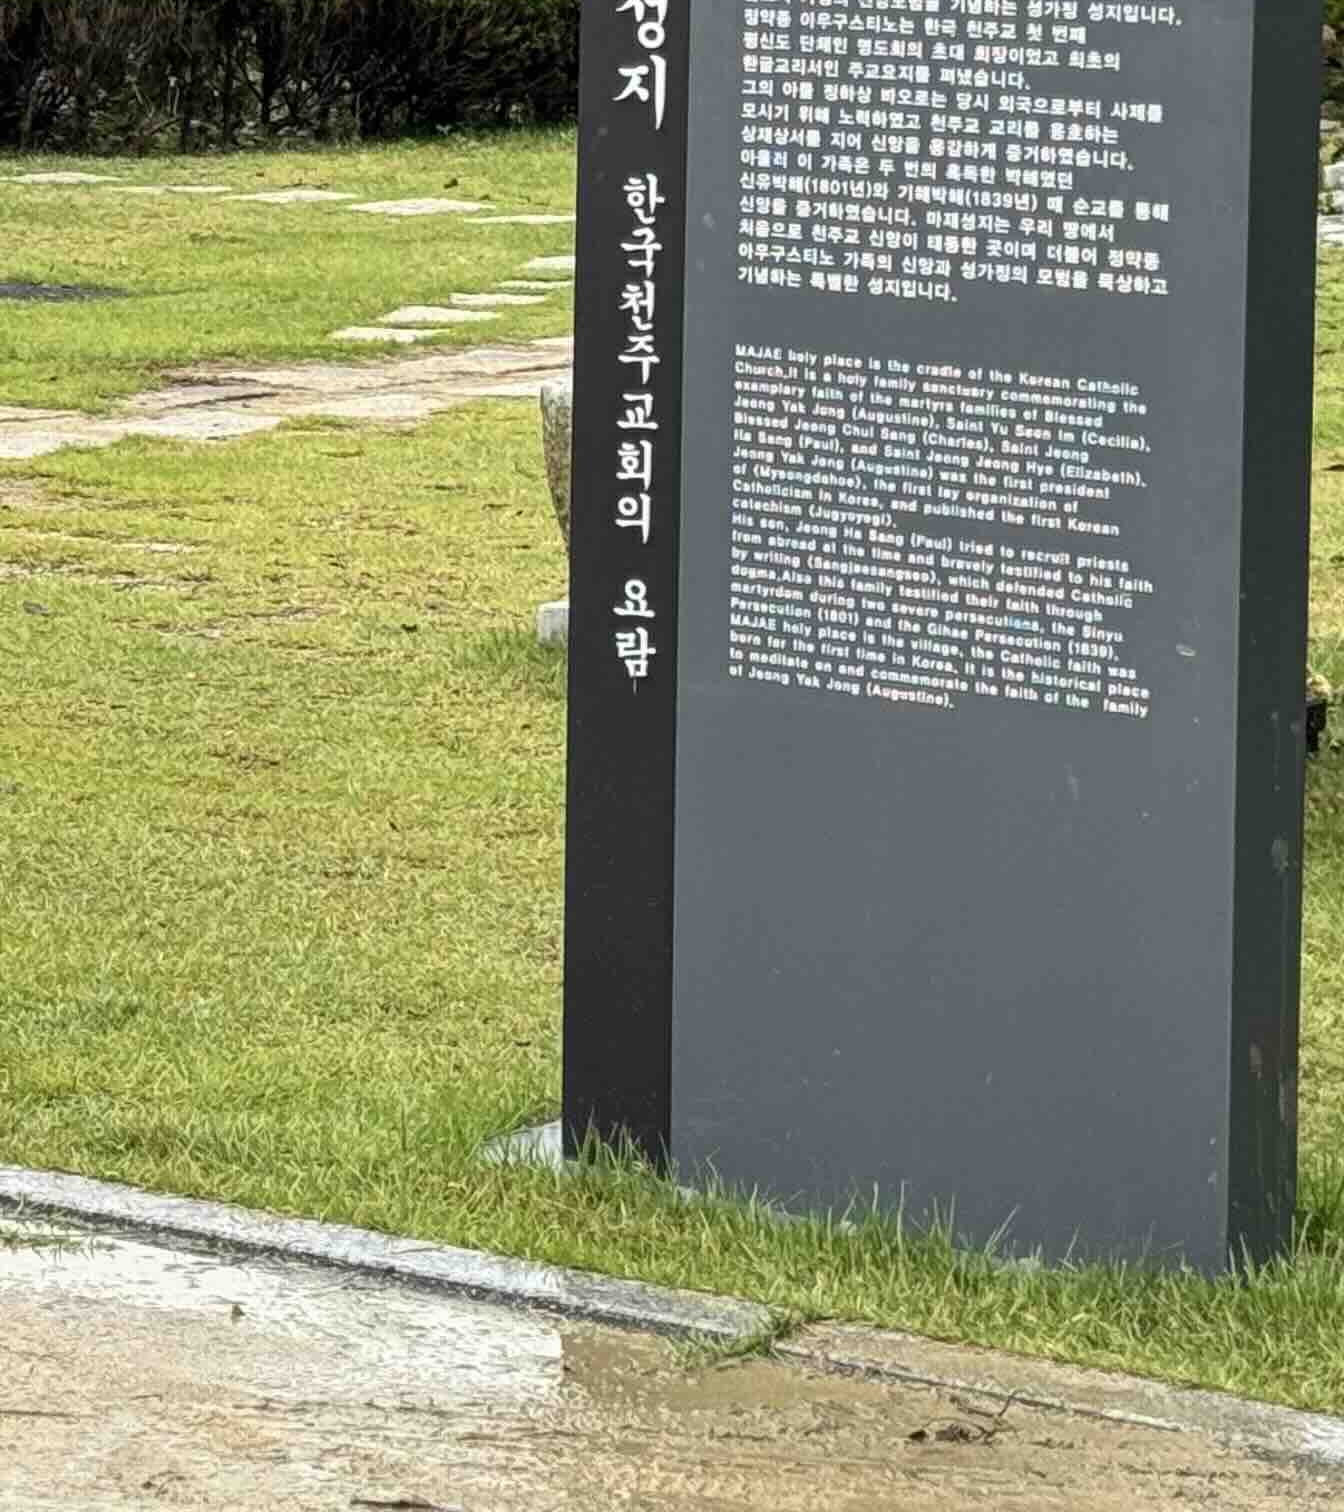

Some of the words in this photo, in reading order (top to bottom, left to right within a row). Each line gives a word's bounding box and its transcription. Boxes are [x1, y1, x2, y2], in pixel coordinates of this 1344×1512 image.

[743, 7, 791, 28] 정약종
[924, 16, 956, 37] 한국
[966, 19, 1016, 39] 천주교
[1025, 22, 1042, 41] 첫
[1026, 0, 1077, 19] 성가정
[1087, 1, 1181, 25] 성지입니다.
[742, 31, 790, 50] 평신도
[799, 34, 847, 54] 단체인
[856, 38, 922, 59] 명도회의
[930, 41, 964, 61] 초대
[973, 44, 1059, 65] 회장이었고
[1068, 49, 1120, 71] 최초의
[742, 53, 838, 77] 한글교리서인
[847, 61, 930, 83] 주교요지를
[740, 102, 789, 121] 모시기
[798, 105, 830, 124] 위해
[837, 108, 921, 129] 노력하였고
[930, 113, 980, 133] 천주교
[988, 119, 1039, 139] 교리를
[741, 79, 773, 96] 그의
[781, 81, 813, 99] 아들
[823, 83, 872, 104] 정하상
[955, 91, 989, 111] 당시
[997, 95, 1101, 119] 외국으로부터
[1110, 101, 1162, 123] 사제를
[740, 124, 820, 147] 상재상서를
[830, 130, 861, 150] 지어
[871, 133, 920, 154] 신앙을
[1005, 143, 1133, 170] 증거하였습니다.
[797, 152, 812, 170] 이
[821, 154, 870, 174] 가족은
[878, 158, 895, 176] 두
[903, 159, 936, 180] 번의
[739, 194, 787, 215] 신앙을
[795, 199, 916, 226] 증거하였습니다.
[925, 210, 1010, 233] 마재성지는
[1018, 217, 1052, 237] 우리
[1072, 197, 1124, 218] 순교를
[738, 218, 802, 239] 처음으로
[811, 223, 860, 244] 천주교
[868, 229, 918, 250] 신앙이
[926, 234, 977, 255] 태동한
[985, 238, 1036, 260] 곳이며
[1107, 248, 1160, 271] 정약종
[737, 265, 802, 287] 기념하는
[809, 271, 859, 292] 특별한
[867, 276, 957, 301] 성지입니다.
[738, 242, 835, 265] 아우구스티노
[843, 250, 892, 272] 가족의
[901, 255, 951, 277] 신앙과
[960, 261, 1027, 284] 성가정의
[1097, 272, 1168, 294] 묵상하고
[616, 174, 664, 543] 한국천주교회의
[735, 343, 781, 360] MAJAE
[787, 349, 816, 365] holy
[823, 353, 862, 368] place
[868, 356, 880, 370] is
[887, 359, 910, 373] the
[916, 364, 961, 378] cradle
[967, 367, 982, 380] of
[989, 369, 1012, 383] the
[1018, 372, 1070, 389] Korean
[1077, 377, 1138, 395] Catholic
[804, 367, 816, 380] is
[822, 372, 831, 382] a
[837, 371, 867, 387] holy
[873, 375, 916, 392] family
[922, 381, 994, 400] sanctuary
[1000, 389, 1116, 413] commemorating
[1122, 400, 1146, 414] the
[731, 529, 761, 544] from
[842, 543, 864, 557] the
[871, 546, 901, 561] time
[907, 553, 934, 565] and
[940, 554, 994, 574] bravely
[1000, 562, 1061, 582] testified
[1068, 571, 1083, 584] to
[1089, 573, 1112, 588] his
[1118, 576, 1152, 592] faith
[614, 580, 656, 677] 요람
[730, 612, 776, 630] MAJAE
[782, 620, 811, 637] holy
[817, 625, 856, 641] place
[862, 630, 875, 644] is
[881, 633, 904, 648] the
[970, 645, 994, 660] the
[1000, 648, 1060, 669] Catholic
[1067, 658, 1101, 674] faith
[1107, 666, 1136, 679] was
[729, 664, 742, 676] of
[748, 665, 789, 685] Jeong
[826, 677, 860, 695] Jong
